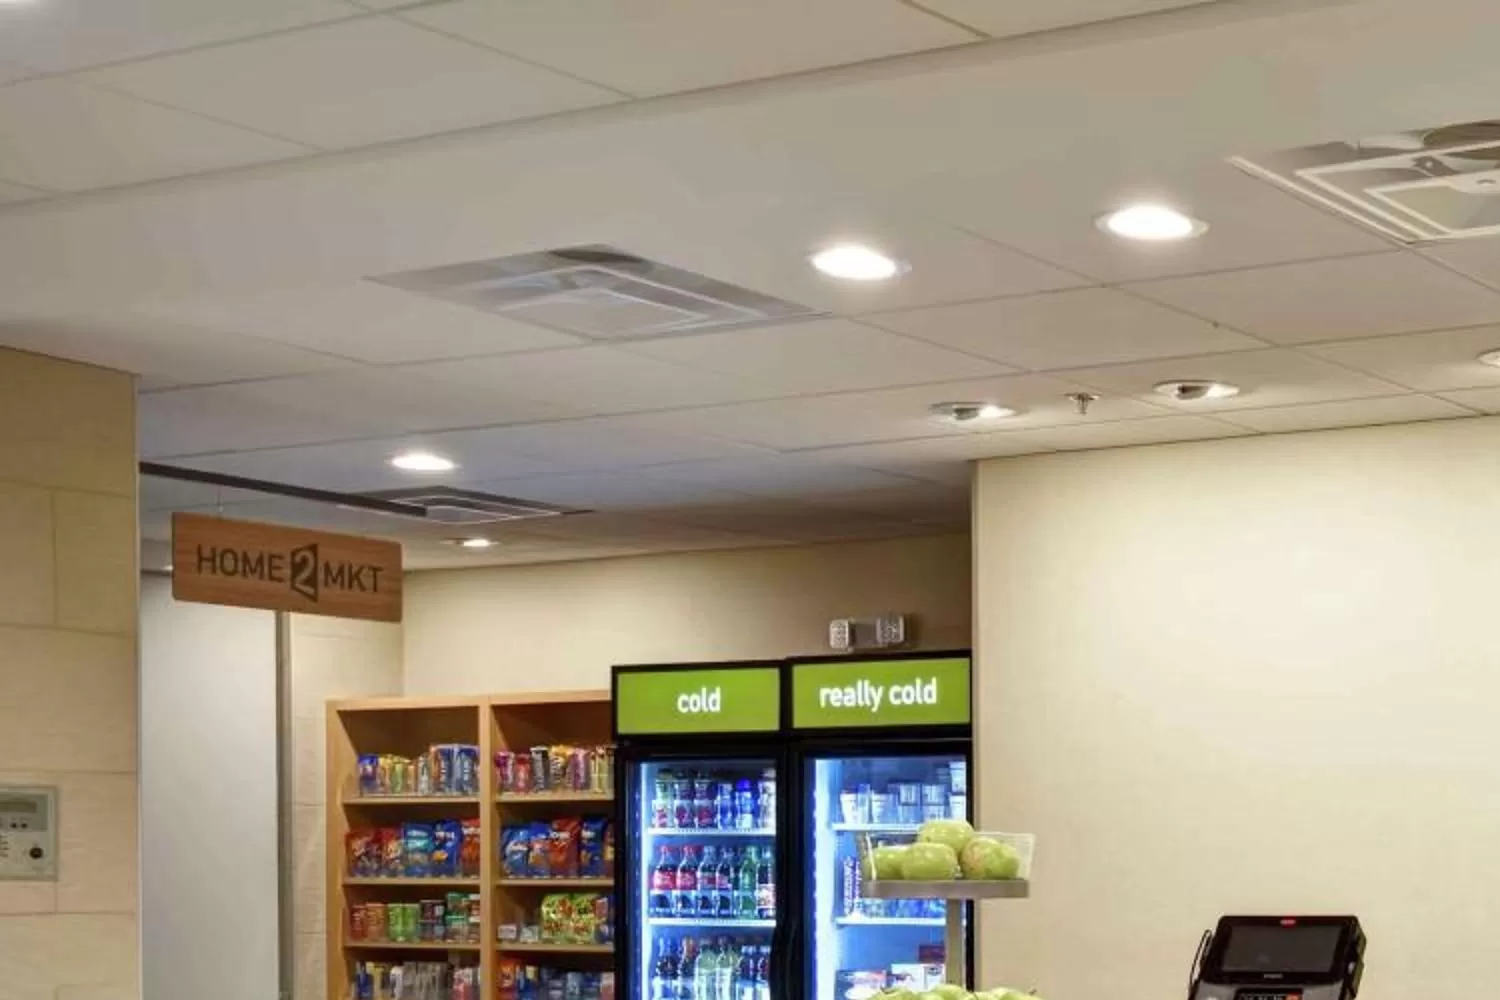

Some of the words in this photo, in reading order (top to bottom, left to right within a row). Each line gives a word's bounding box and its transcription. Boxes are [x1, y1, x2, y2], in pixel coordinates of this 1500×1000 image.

[196, 543, 285, 582] HOME
[323, 560, 385, 593] MKT
[677, 685, 721, 713] cold
[819, 679, 883, 712] really
[888, 676, 938, 705] cold
